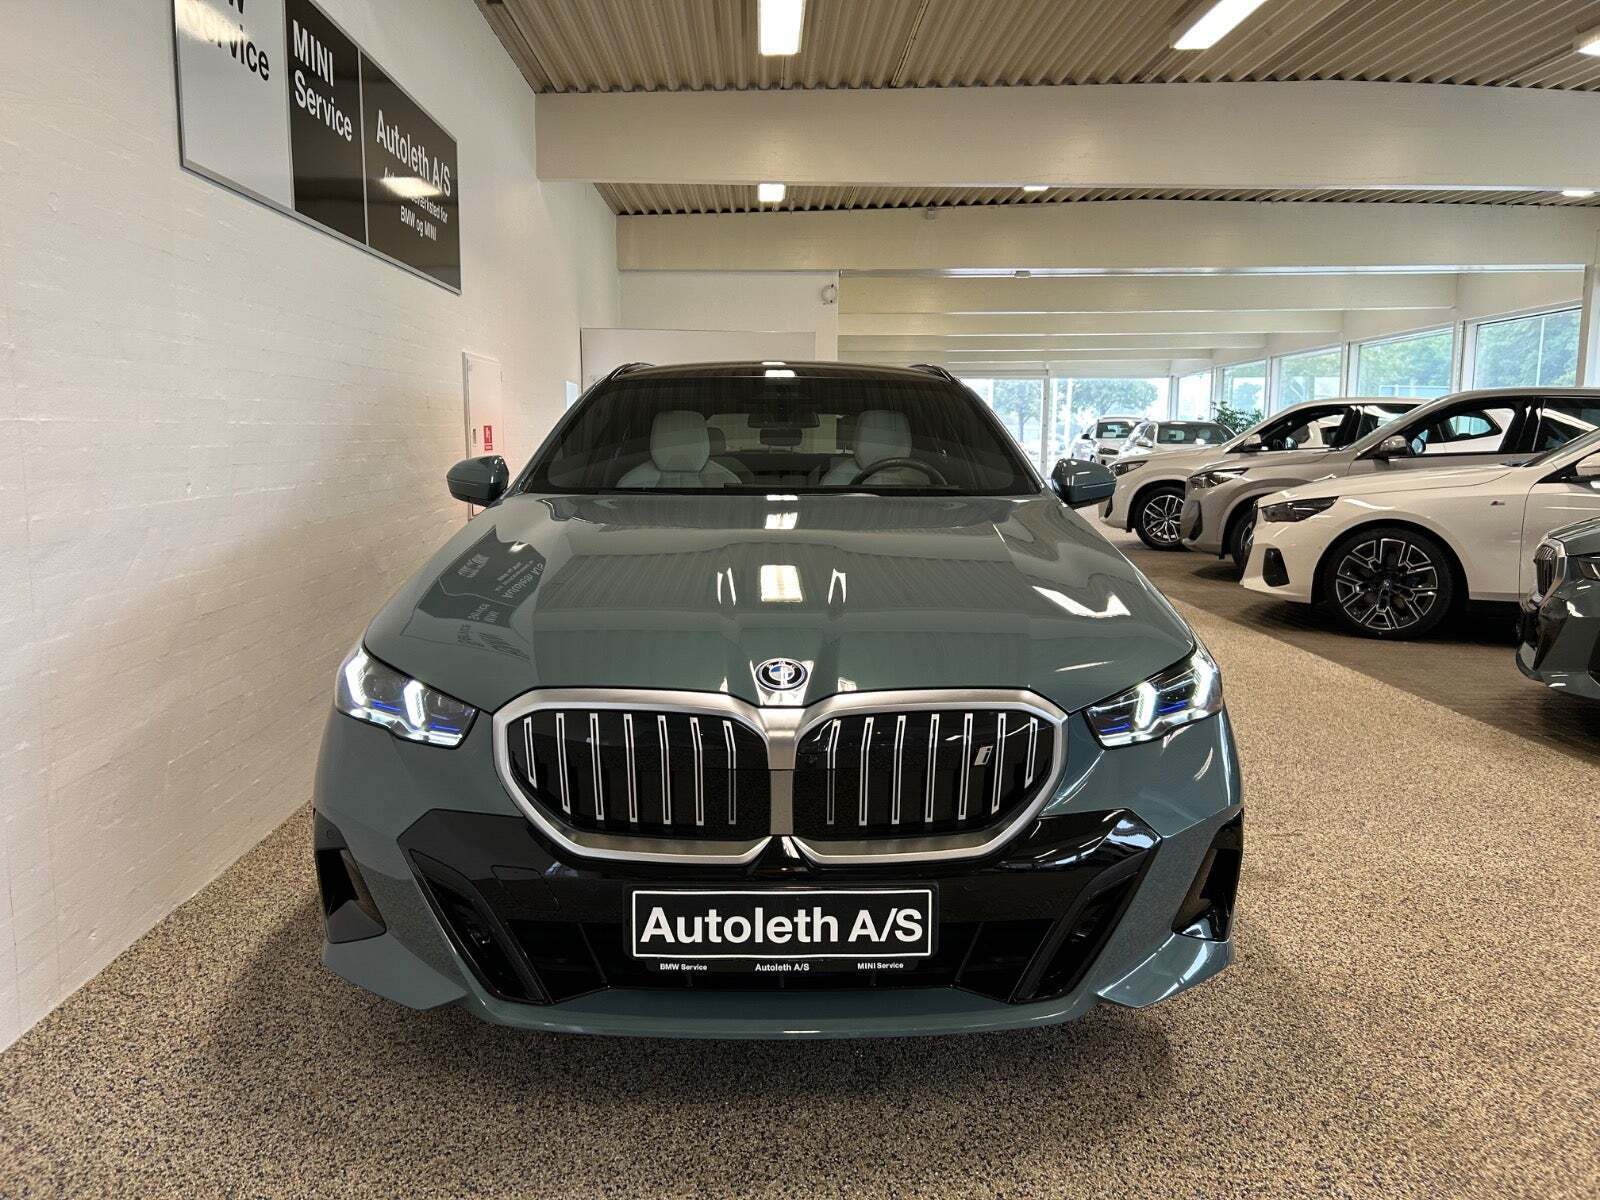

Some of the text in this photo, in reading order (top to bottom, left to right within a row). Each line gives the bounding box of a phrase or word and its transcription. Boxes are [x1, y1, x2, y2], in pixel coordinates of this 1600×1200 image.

[292, 19, 334, 87] MINI
[294, 69, 353, 142] Service
[376, 108, 451, 197] Autoleth A/S
[400, 204, 437, 241] BMW og MINI
[640, 906, 923, 944] Autoleth A/S
[681, 963, 708, 971] Service
[755, 963, 810, 972] Autoleth A/S
[857, 961, 904, 970] MINI Service
